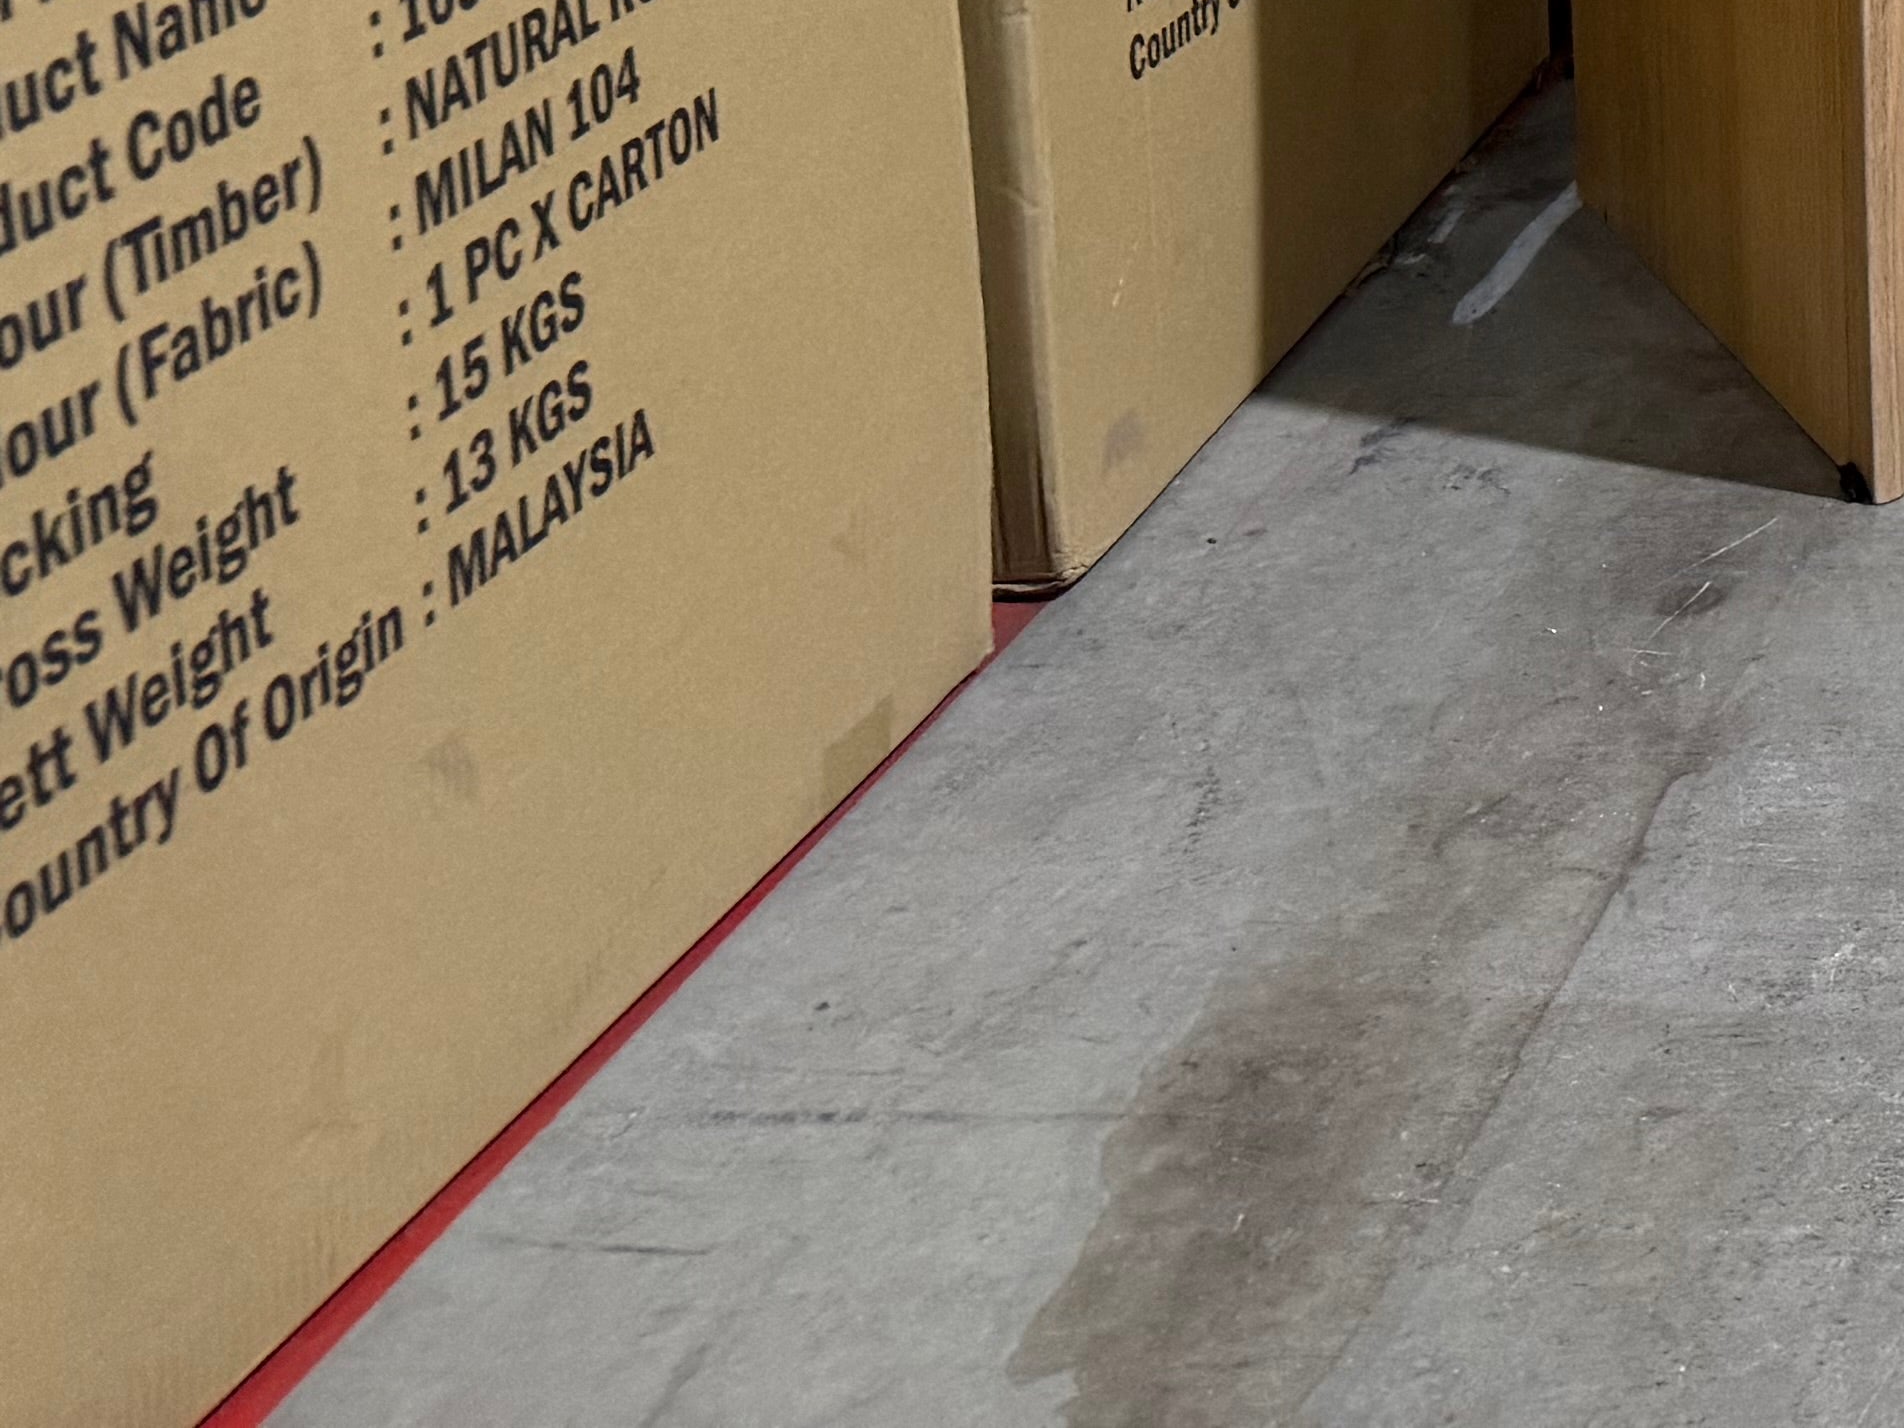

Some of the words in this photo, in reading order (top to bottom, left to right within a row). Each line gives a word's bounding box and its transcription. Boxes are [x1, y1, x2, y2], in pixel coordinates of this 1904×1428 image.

[0, 448, 159, 598] cking
[425, 260, 454, 328] 1
[463, 216, 523, 305] PC
[529, 189, 561, 262] X
[566, 86, 719, 232] CARTON
[0, 766, 180, 939] ountry
[192, 696, 250, 794] Of
[261, 604, 404, 742] Origin
[446, 407, 655, 608] MALAYSIA
